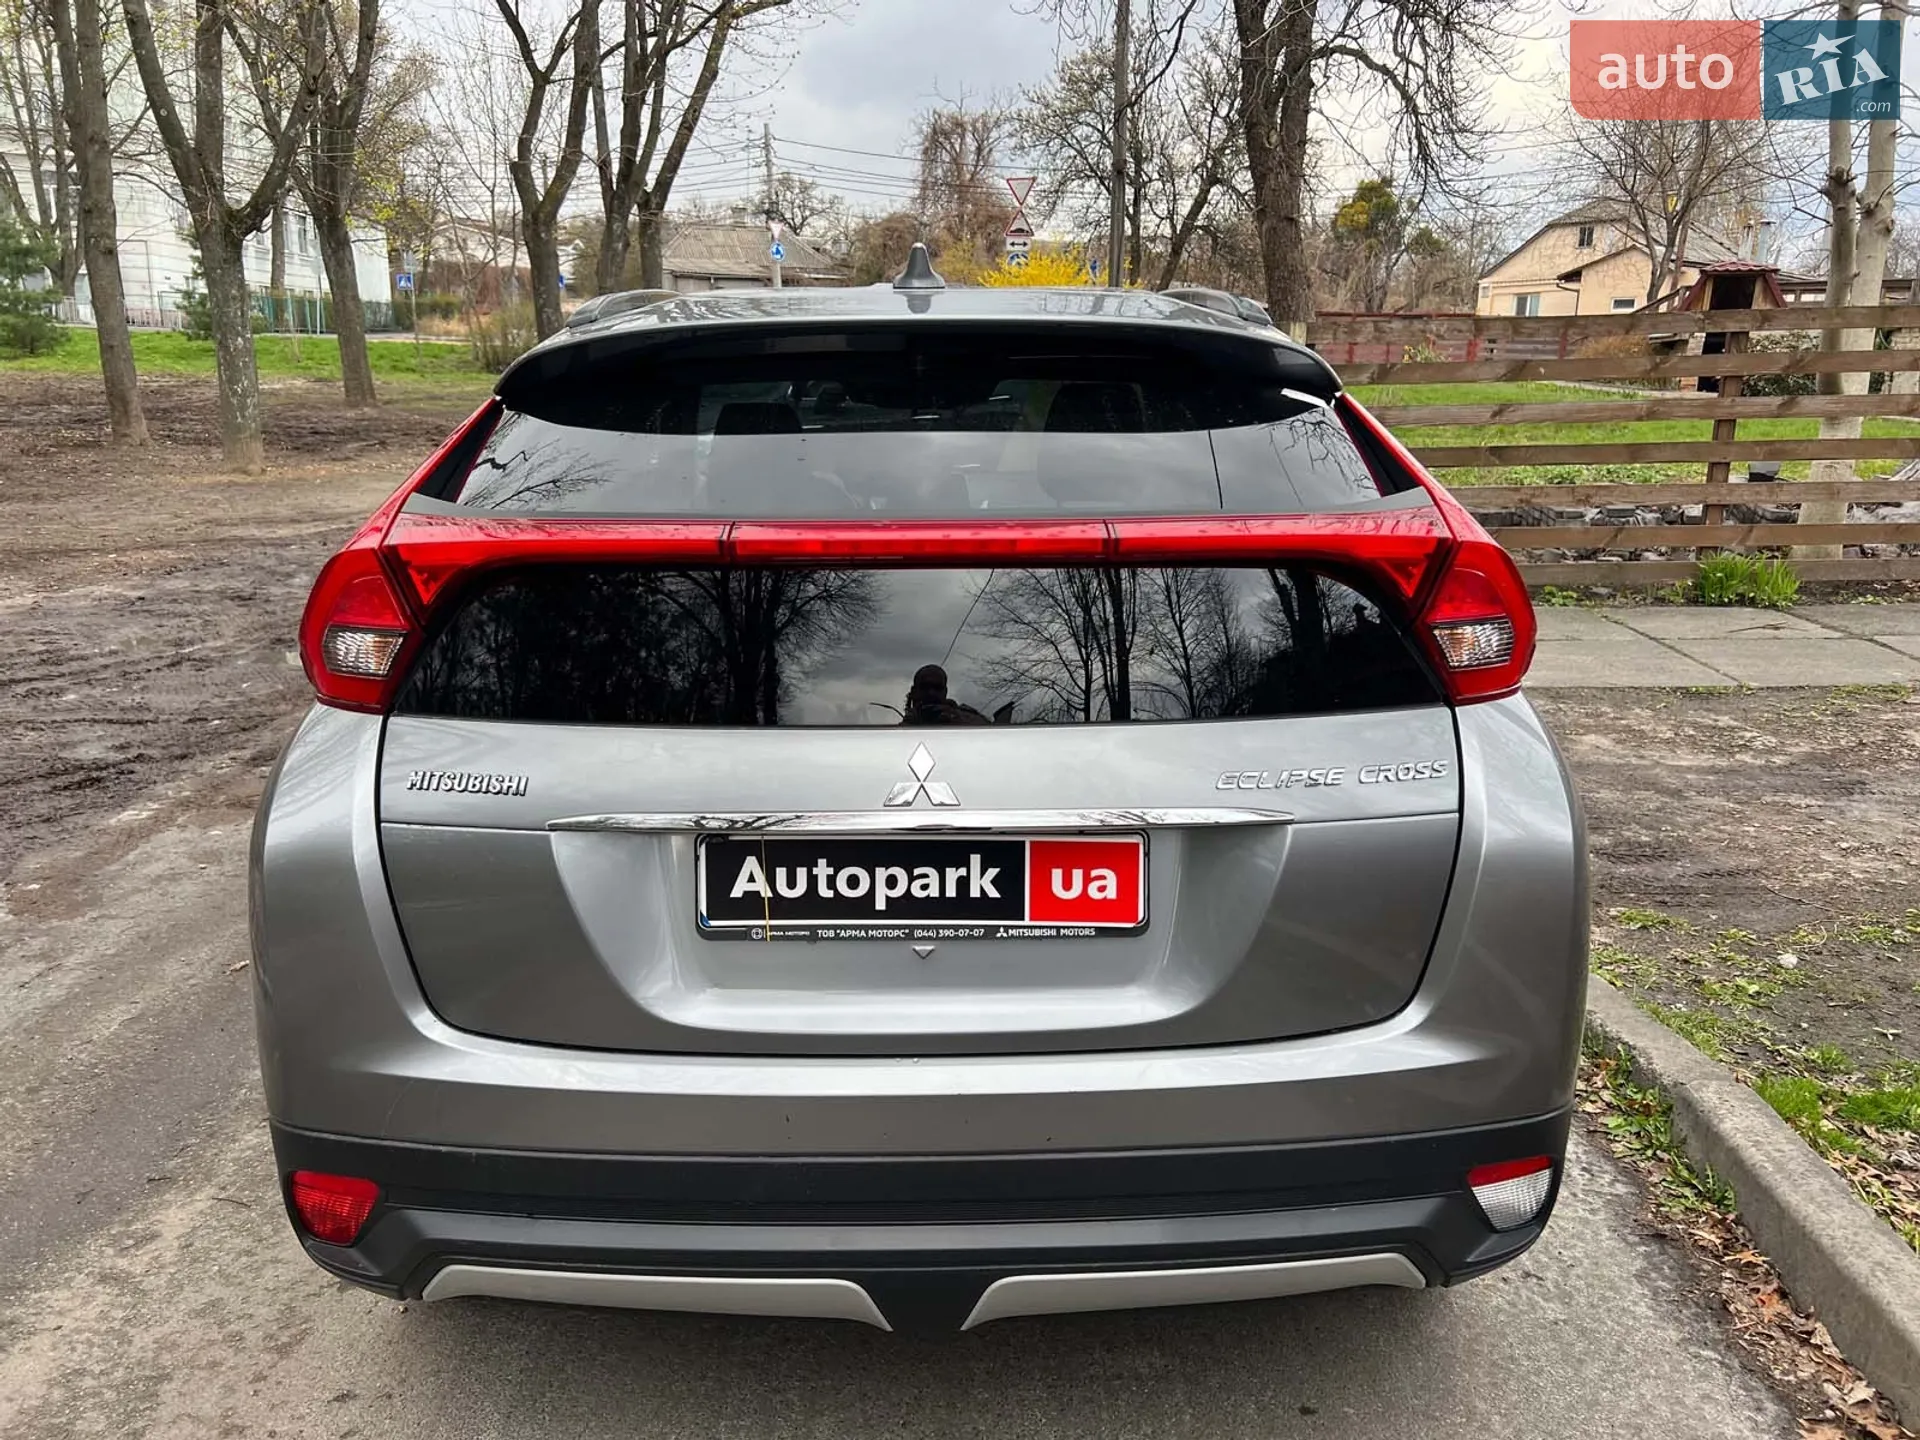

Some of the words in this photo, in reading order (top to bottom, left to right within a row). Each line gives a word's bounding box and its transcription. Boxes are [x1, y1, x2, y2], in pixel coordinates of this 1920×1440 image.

[406, 771, 529, 796] MITSUBISHI
[1216, 767, 1346, 789] ECLIPSE
[1358, 760, 1449, 784] CROSS
[730, 854, 1001, 910] Autopark
[1050, 867, 1118, 900] ua
[817, 929, 835, 938] ТОВ
[914, 928, 936, 938] (044)
[938, 928, 985, 938] 390-07-07
[1008, 928, 1057, 937] MITSUBISHI
[1060, 927, 1096, 936] MOTORS
